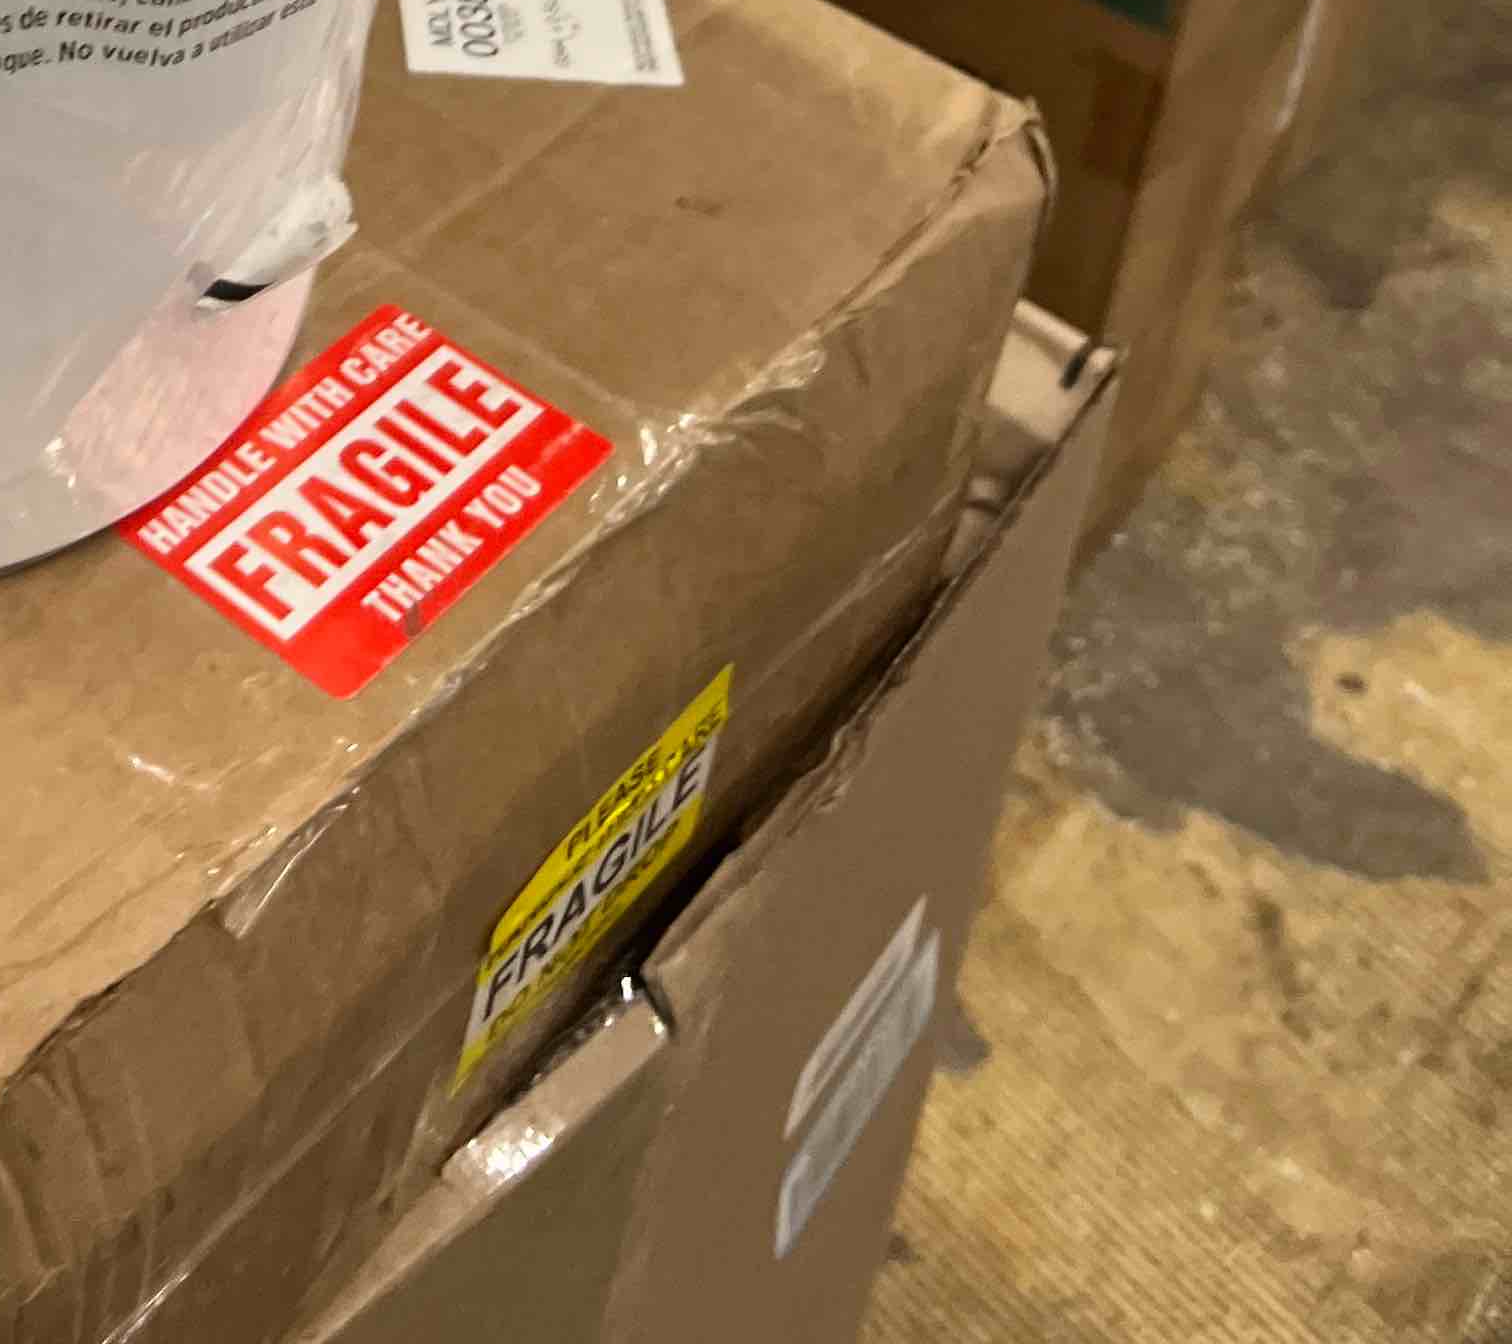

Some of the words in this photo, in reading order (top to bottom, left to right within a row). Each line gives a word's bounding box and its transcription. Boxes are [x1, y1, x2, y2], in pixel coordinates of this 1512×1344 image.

[19, 4, 49, 30] de
[54, 8, 143, 35] retirar
[147, 18, 174, 38] el
[58, 40, 94, 63] No
[101, 42, 186, 67] vuelva
[190, 42, 207, 60] a
[137, 439, 277, 556] HANDLE
[267, 380, 349, 459] WITH
[342, 312, 434, 390] CARE
[211, 356, 521, 622] FRAGILE
[361, 519, 481, 622] THANK
[468, 464, 543, 547] YOU
[483, 747, 706, 1023] FRAGILE
